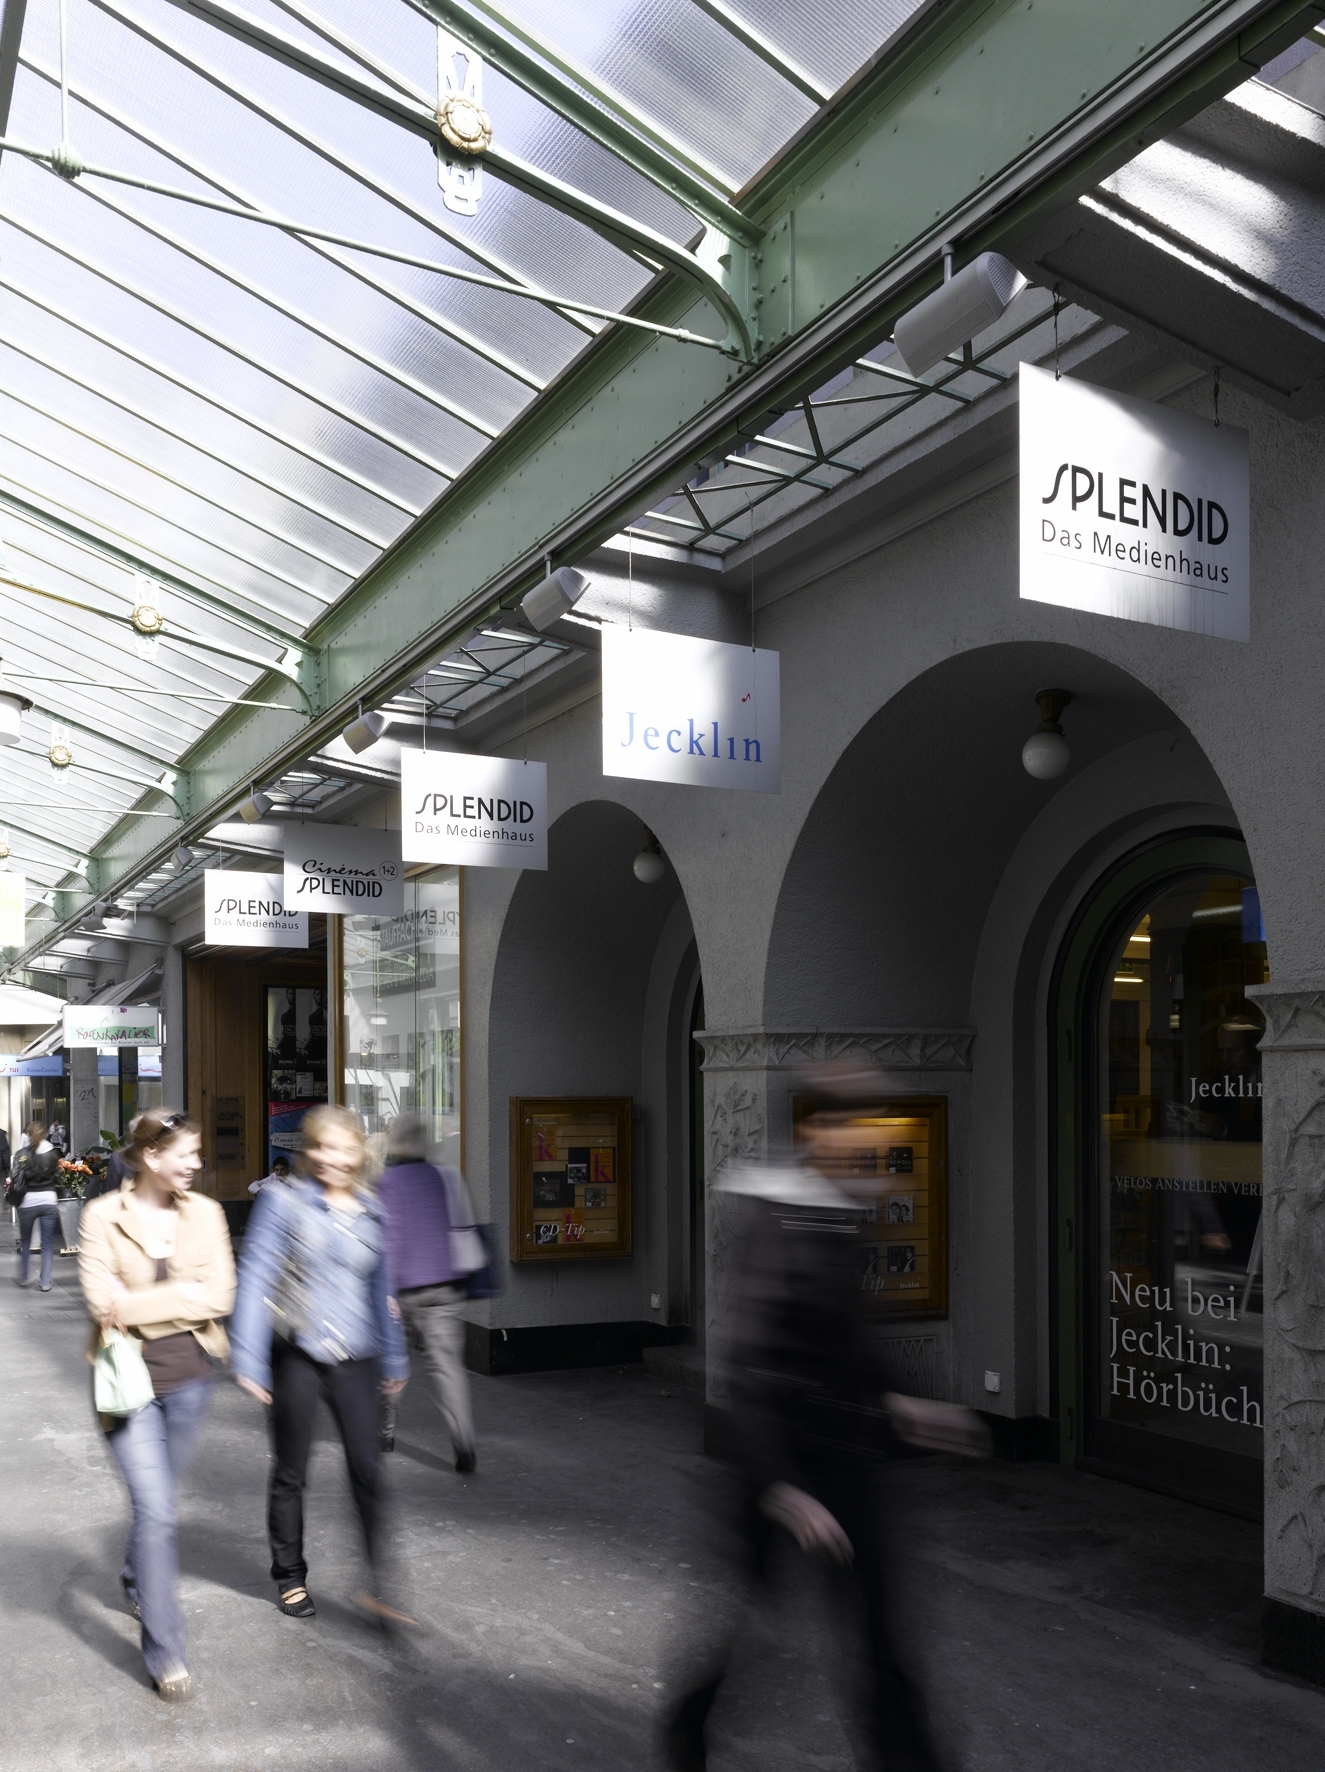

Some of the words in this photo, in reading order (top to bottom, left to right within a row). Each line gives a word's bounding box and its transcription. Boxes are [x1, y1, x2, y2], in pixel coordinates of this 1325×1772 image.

[1042, 463, 1229, 545] SPLENDID
[1041, 519, 1083, 550] Das
[1093, 531, 1229, 584] Medienhaus
[620, 711, 763, 763] Jecklin
[415, 793, 534, 823] SPLENDID
[415, 821, 441, 835] Das
[446, 823, 535, 843] Medienhaus
[302, 859, 377, 876] Cinéma
[297, 877, 383, 898] SPLENDID
[214, 917, 233, 926] Das
[236, 919, 299, 930] Medienhaus
[1115, 1175, 1152, 1189] VELOS
[1155, 1177, 1228, 1194] ANSTELLEN
[540, 1223, 586, 1239] CD-Tip
[1109, 1271, 1174, 1311] Neu
[1184, 1277, 1238, 1321] bei
[1109, 1317, 1231, 1371] Jecklin:
[1110, 1362, 1264, 1428] Hörbüch
